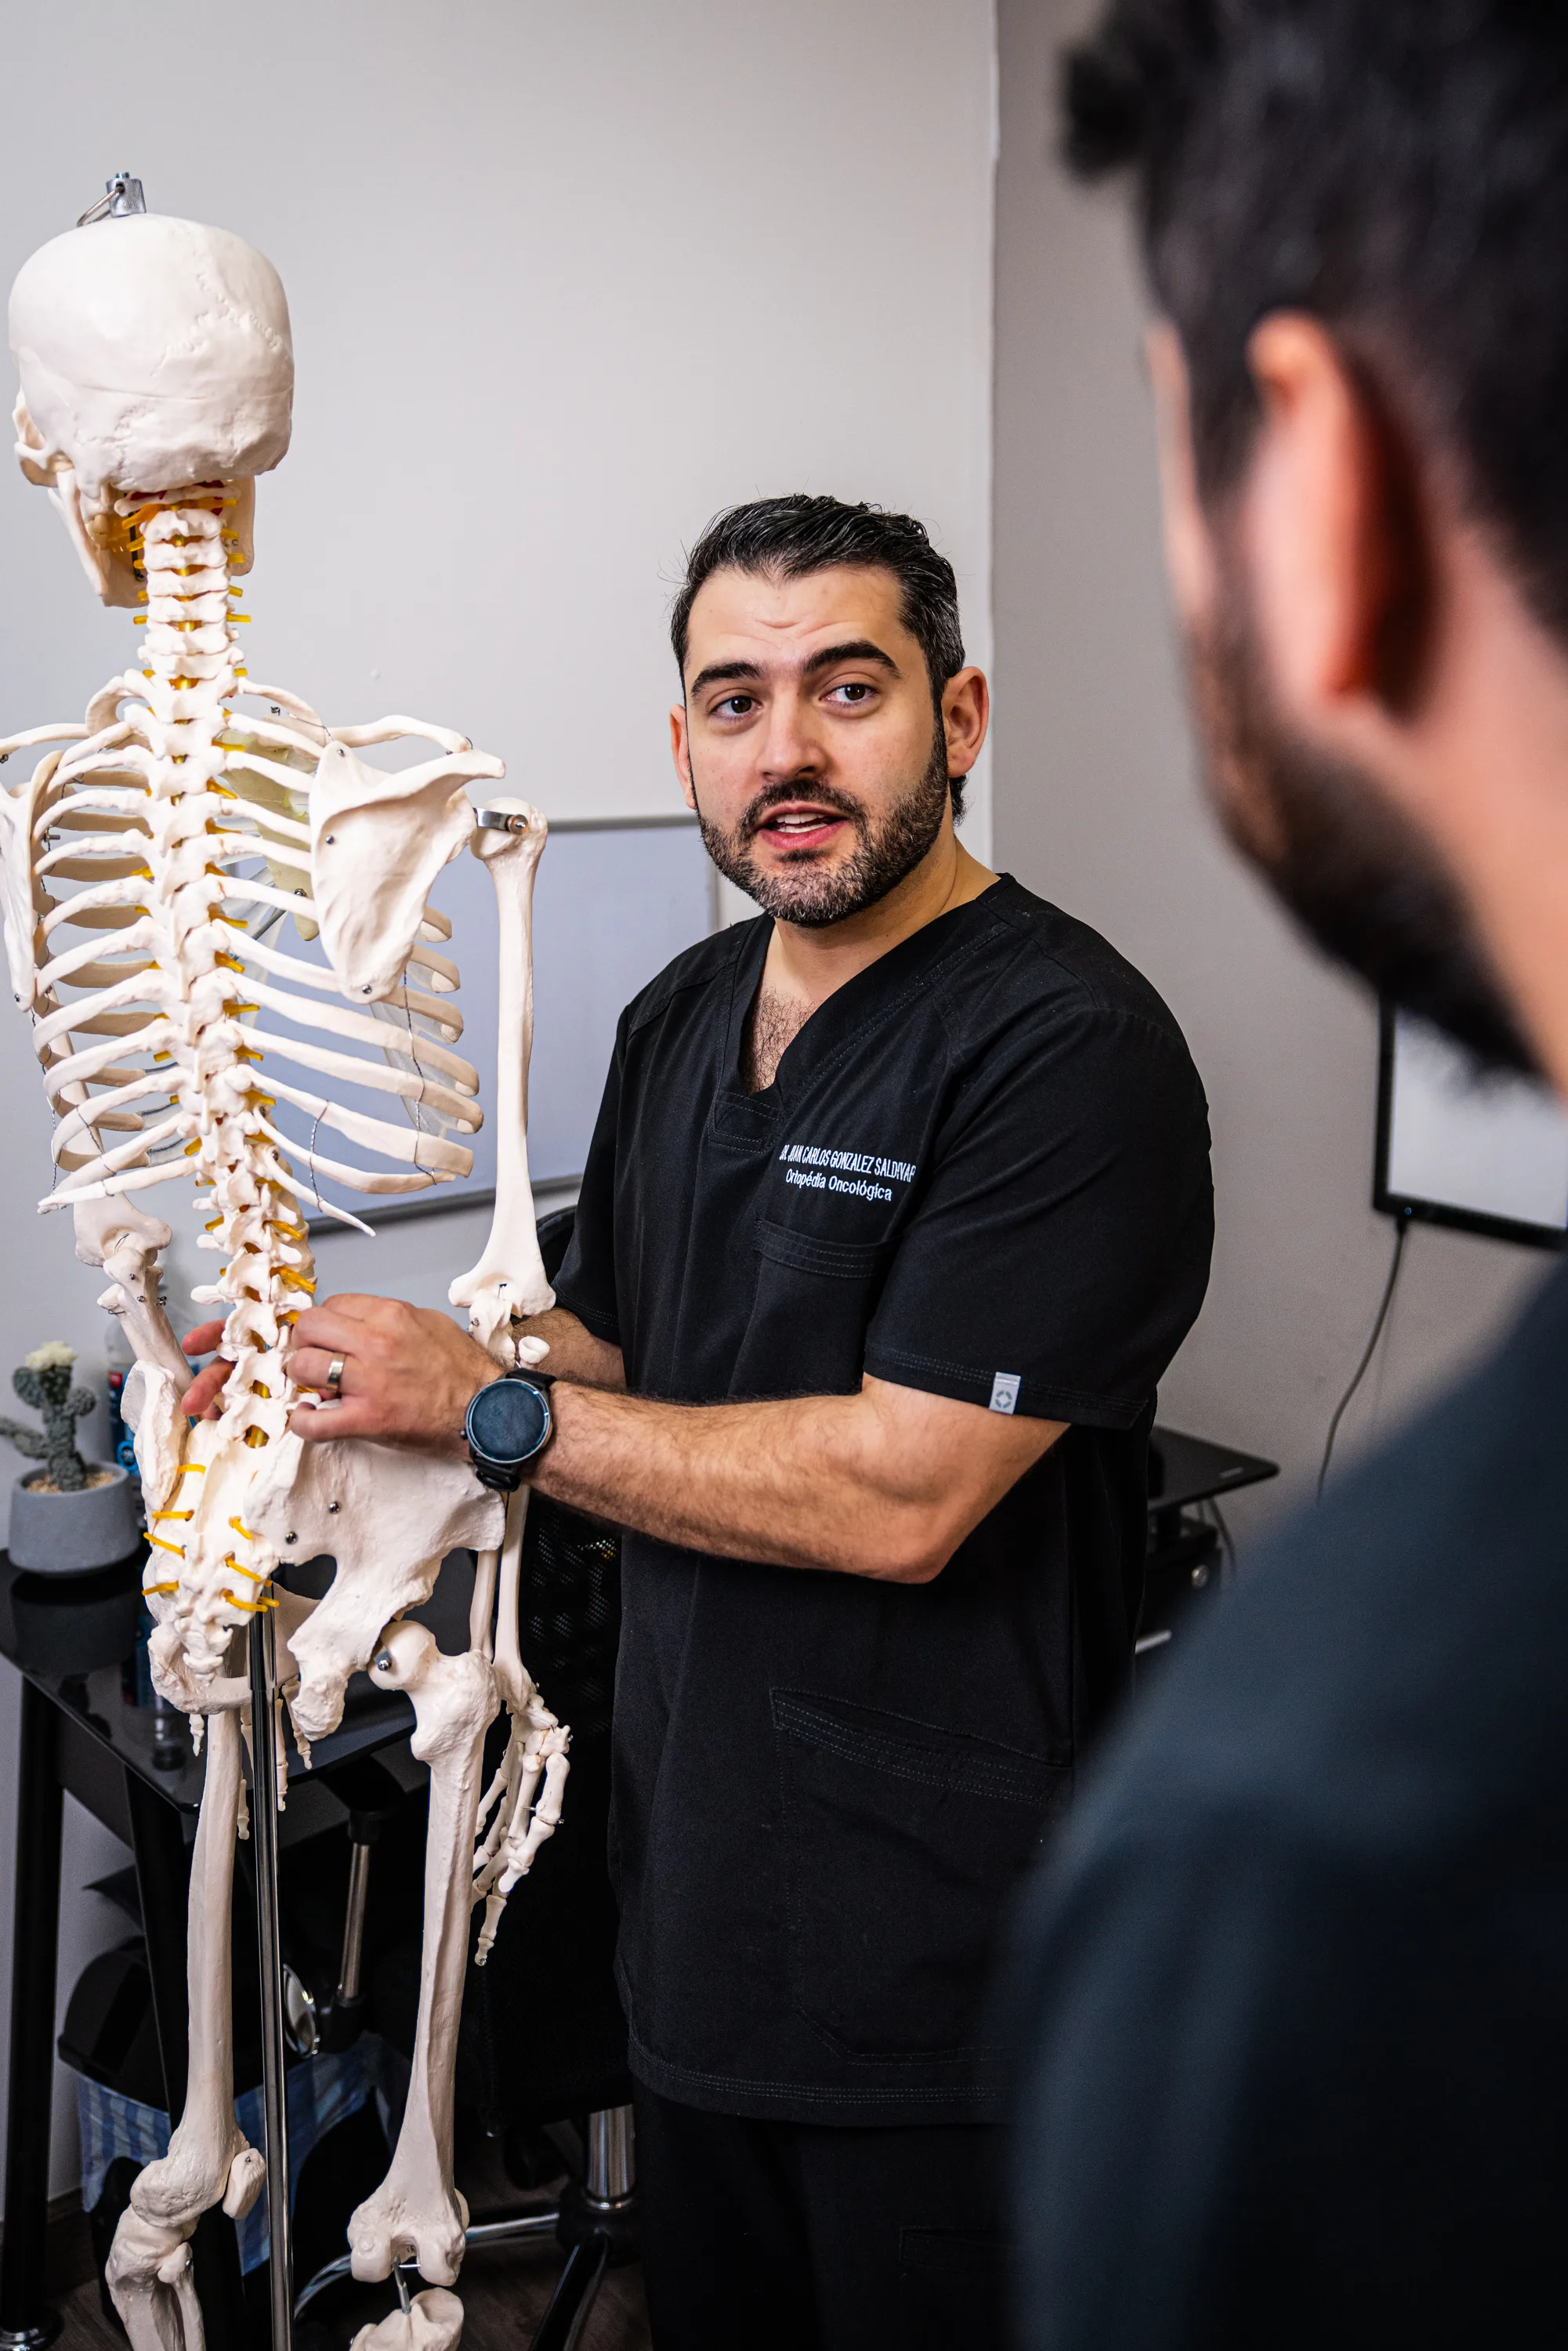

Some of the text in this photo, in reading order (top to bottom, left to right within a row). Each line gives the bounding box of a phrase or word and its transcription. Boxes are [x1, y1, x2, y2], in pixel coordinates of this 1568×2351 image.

[802, 1146, 831, 1166] CARLOS
[829, 1150, 875, 1174] GONZALEZ
[828, 1175, 893, 1201] Oncológica
